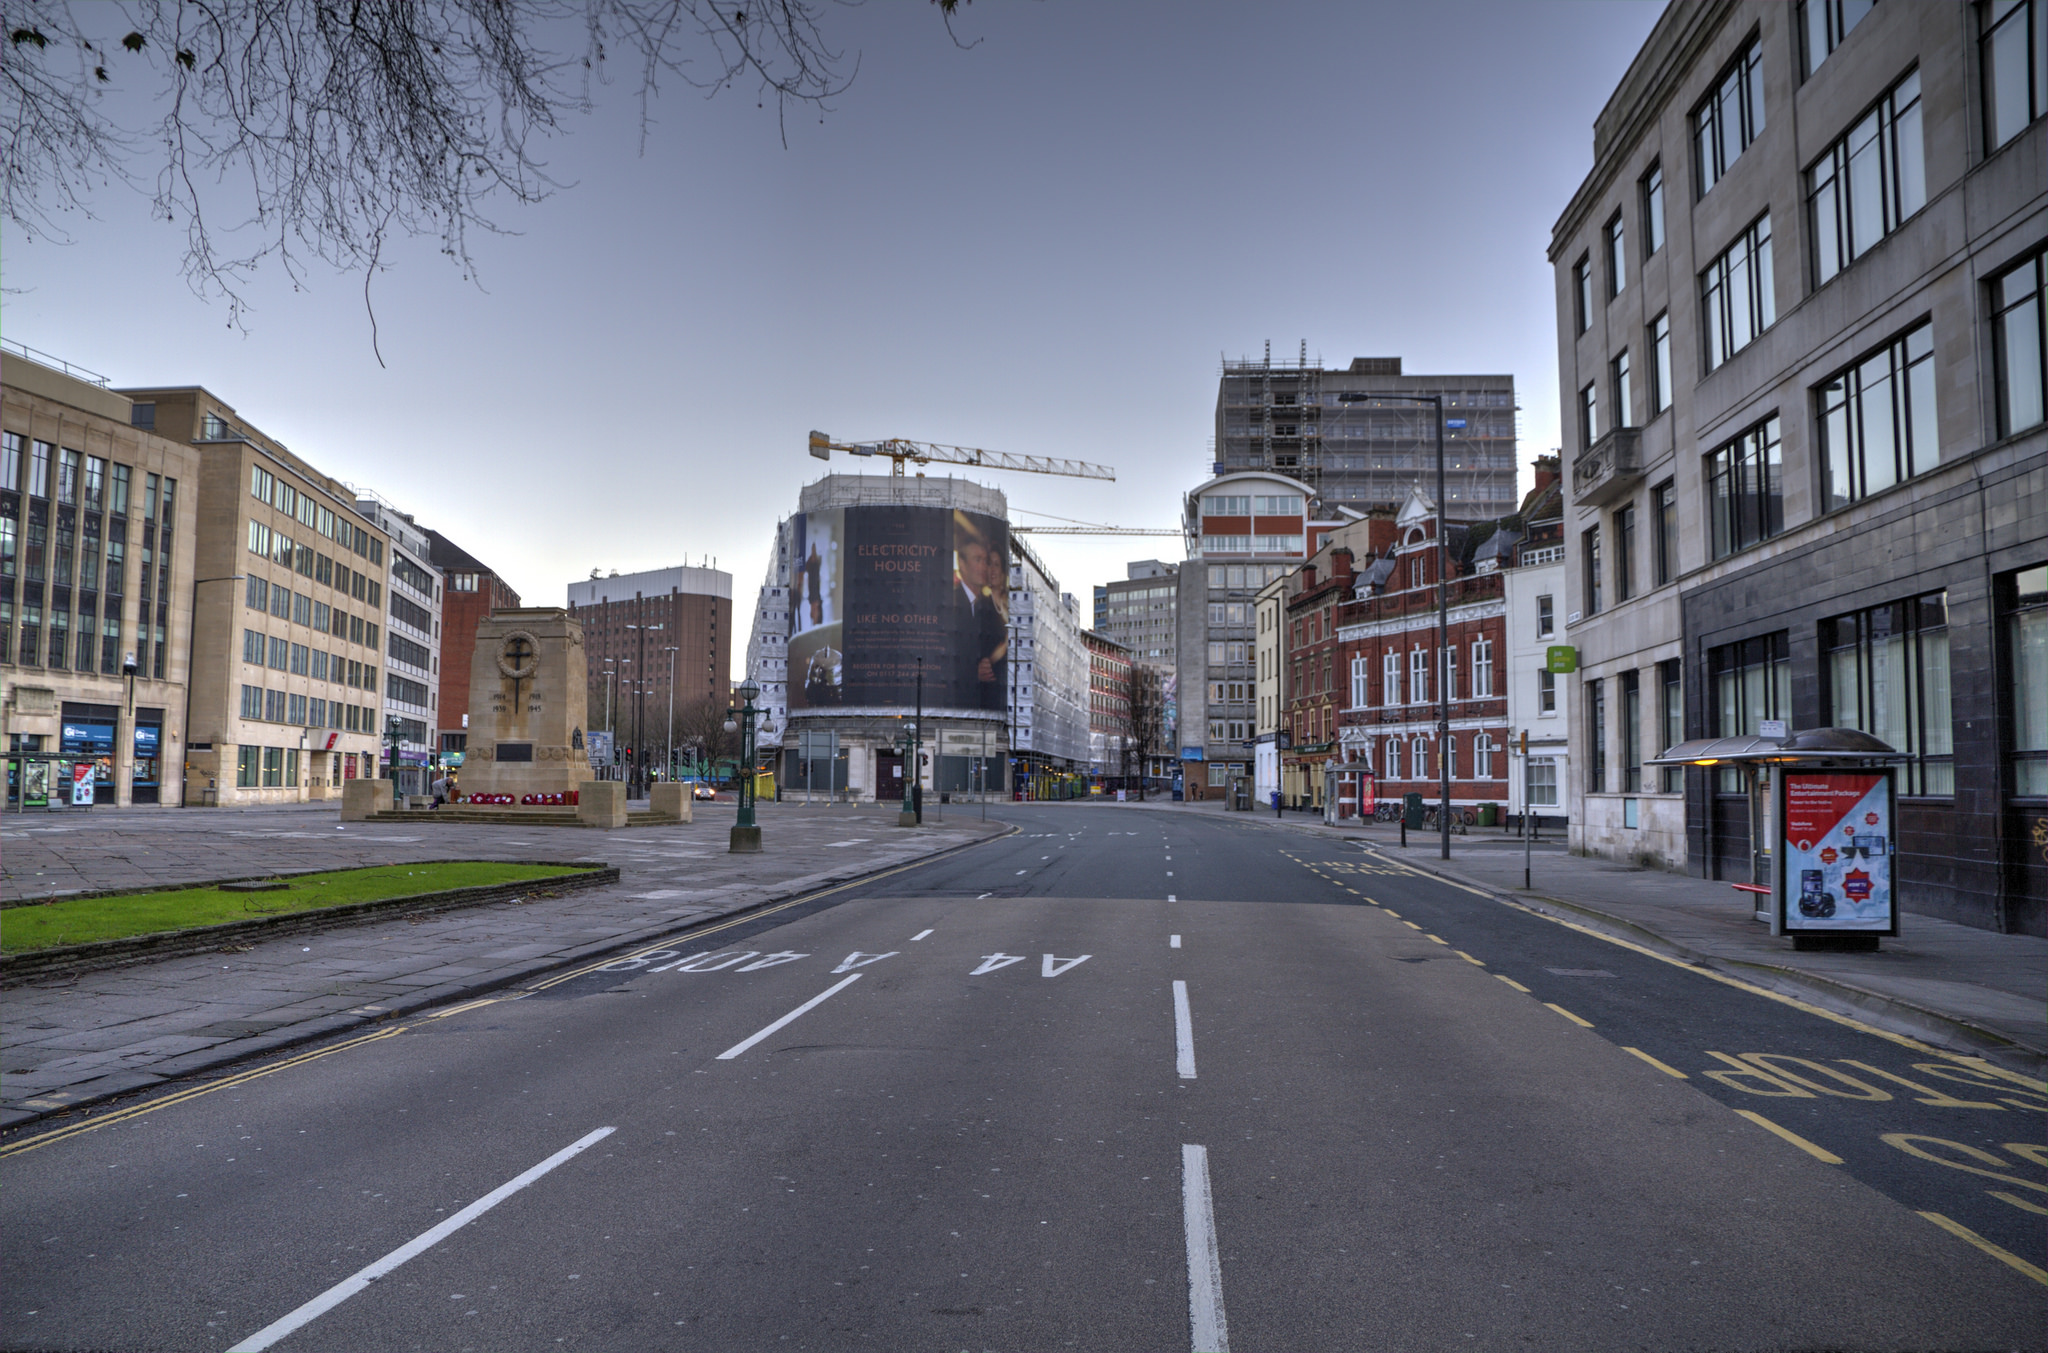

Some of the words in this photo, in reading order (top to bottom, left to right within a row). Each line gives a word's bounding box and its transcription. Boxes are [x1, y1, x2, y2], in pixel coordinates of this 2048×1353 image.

[859, 544, 938, 557] ELECTRICITY
[874, 560, 921, 573] HOUSE
[857, 614, 878, 624] LIKE
[881, 614, 900, 624] NO
[903, 614, 939, 625] OTHER
[1834, 790, 1860, 798] Package
[968, 952, 1093, 978] A4
